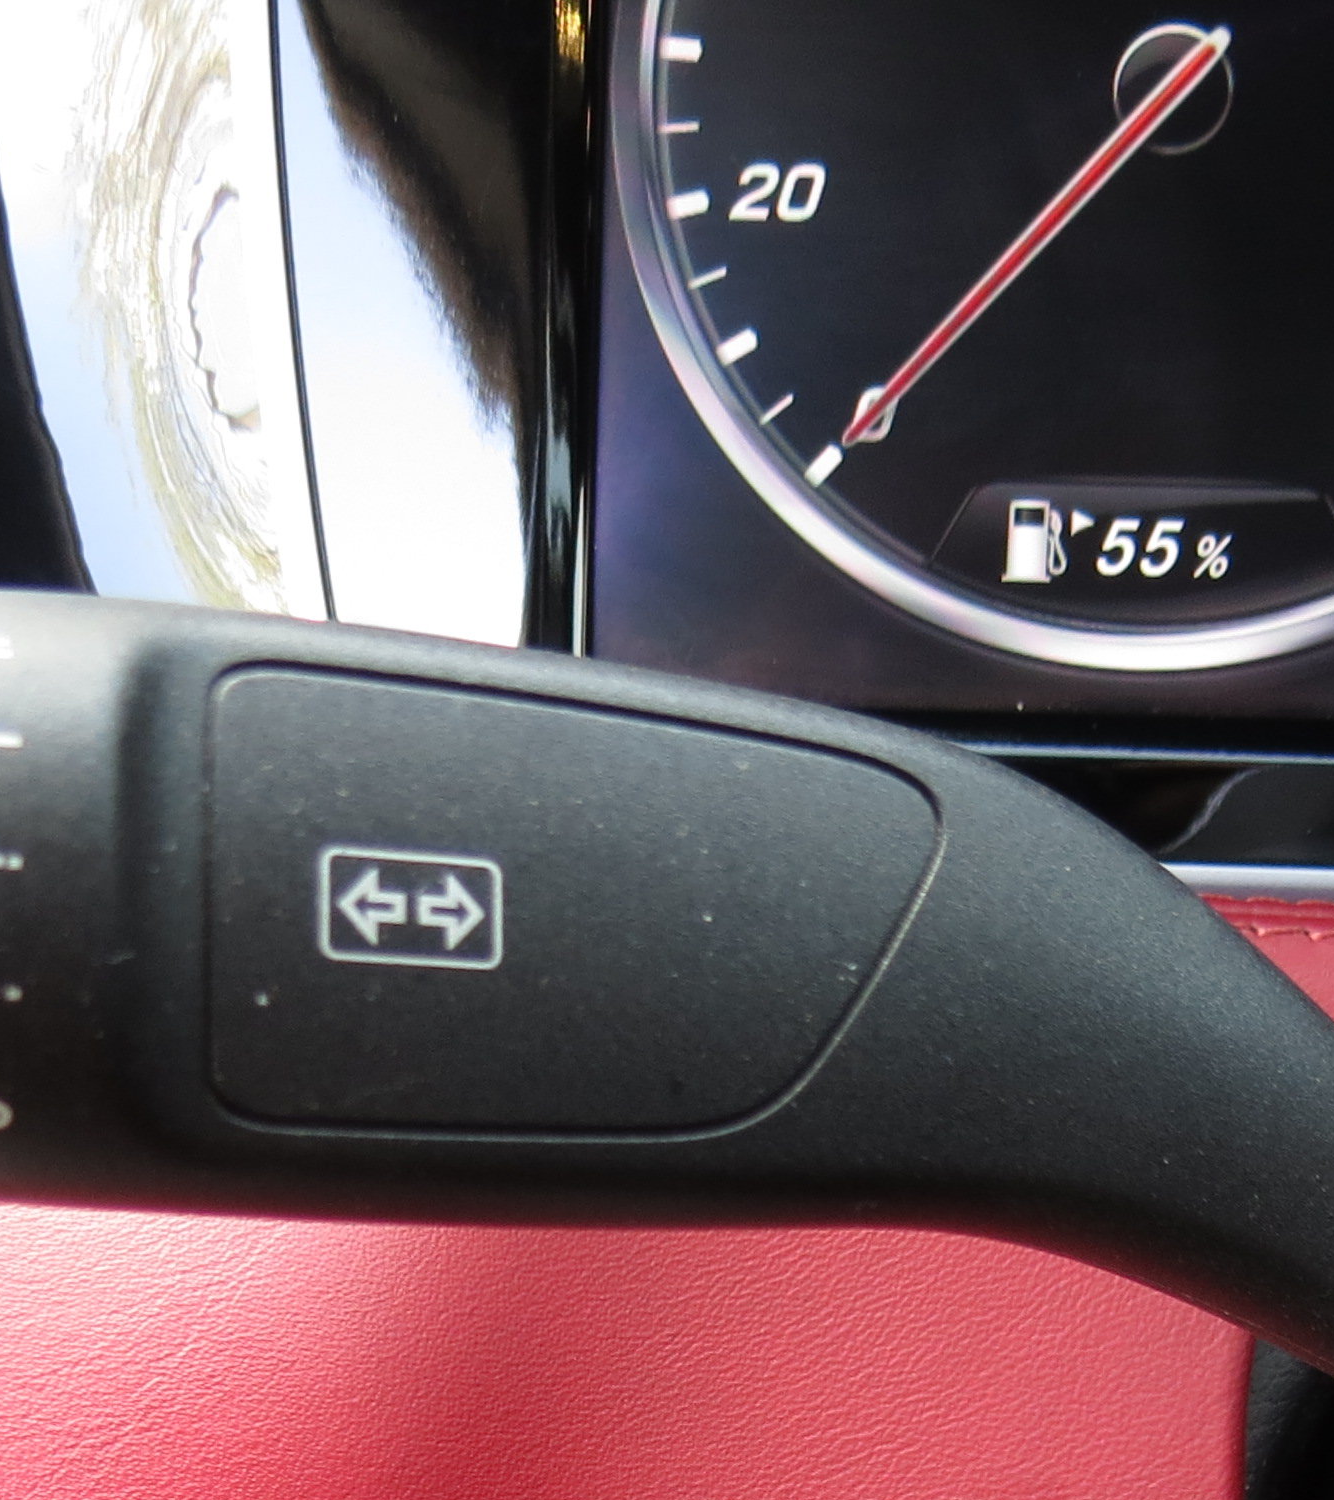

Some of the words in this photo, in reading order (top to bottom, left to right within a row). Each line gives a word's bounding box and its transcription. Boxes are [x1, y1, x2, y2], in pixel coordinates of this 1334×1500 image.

[729, 163, 825, 222] 20
[1096, 519, 1184, 578] 55
[1193, 534, 1232, 579] %
